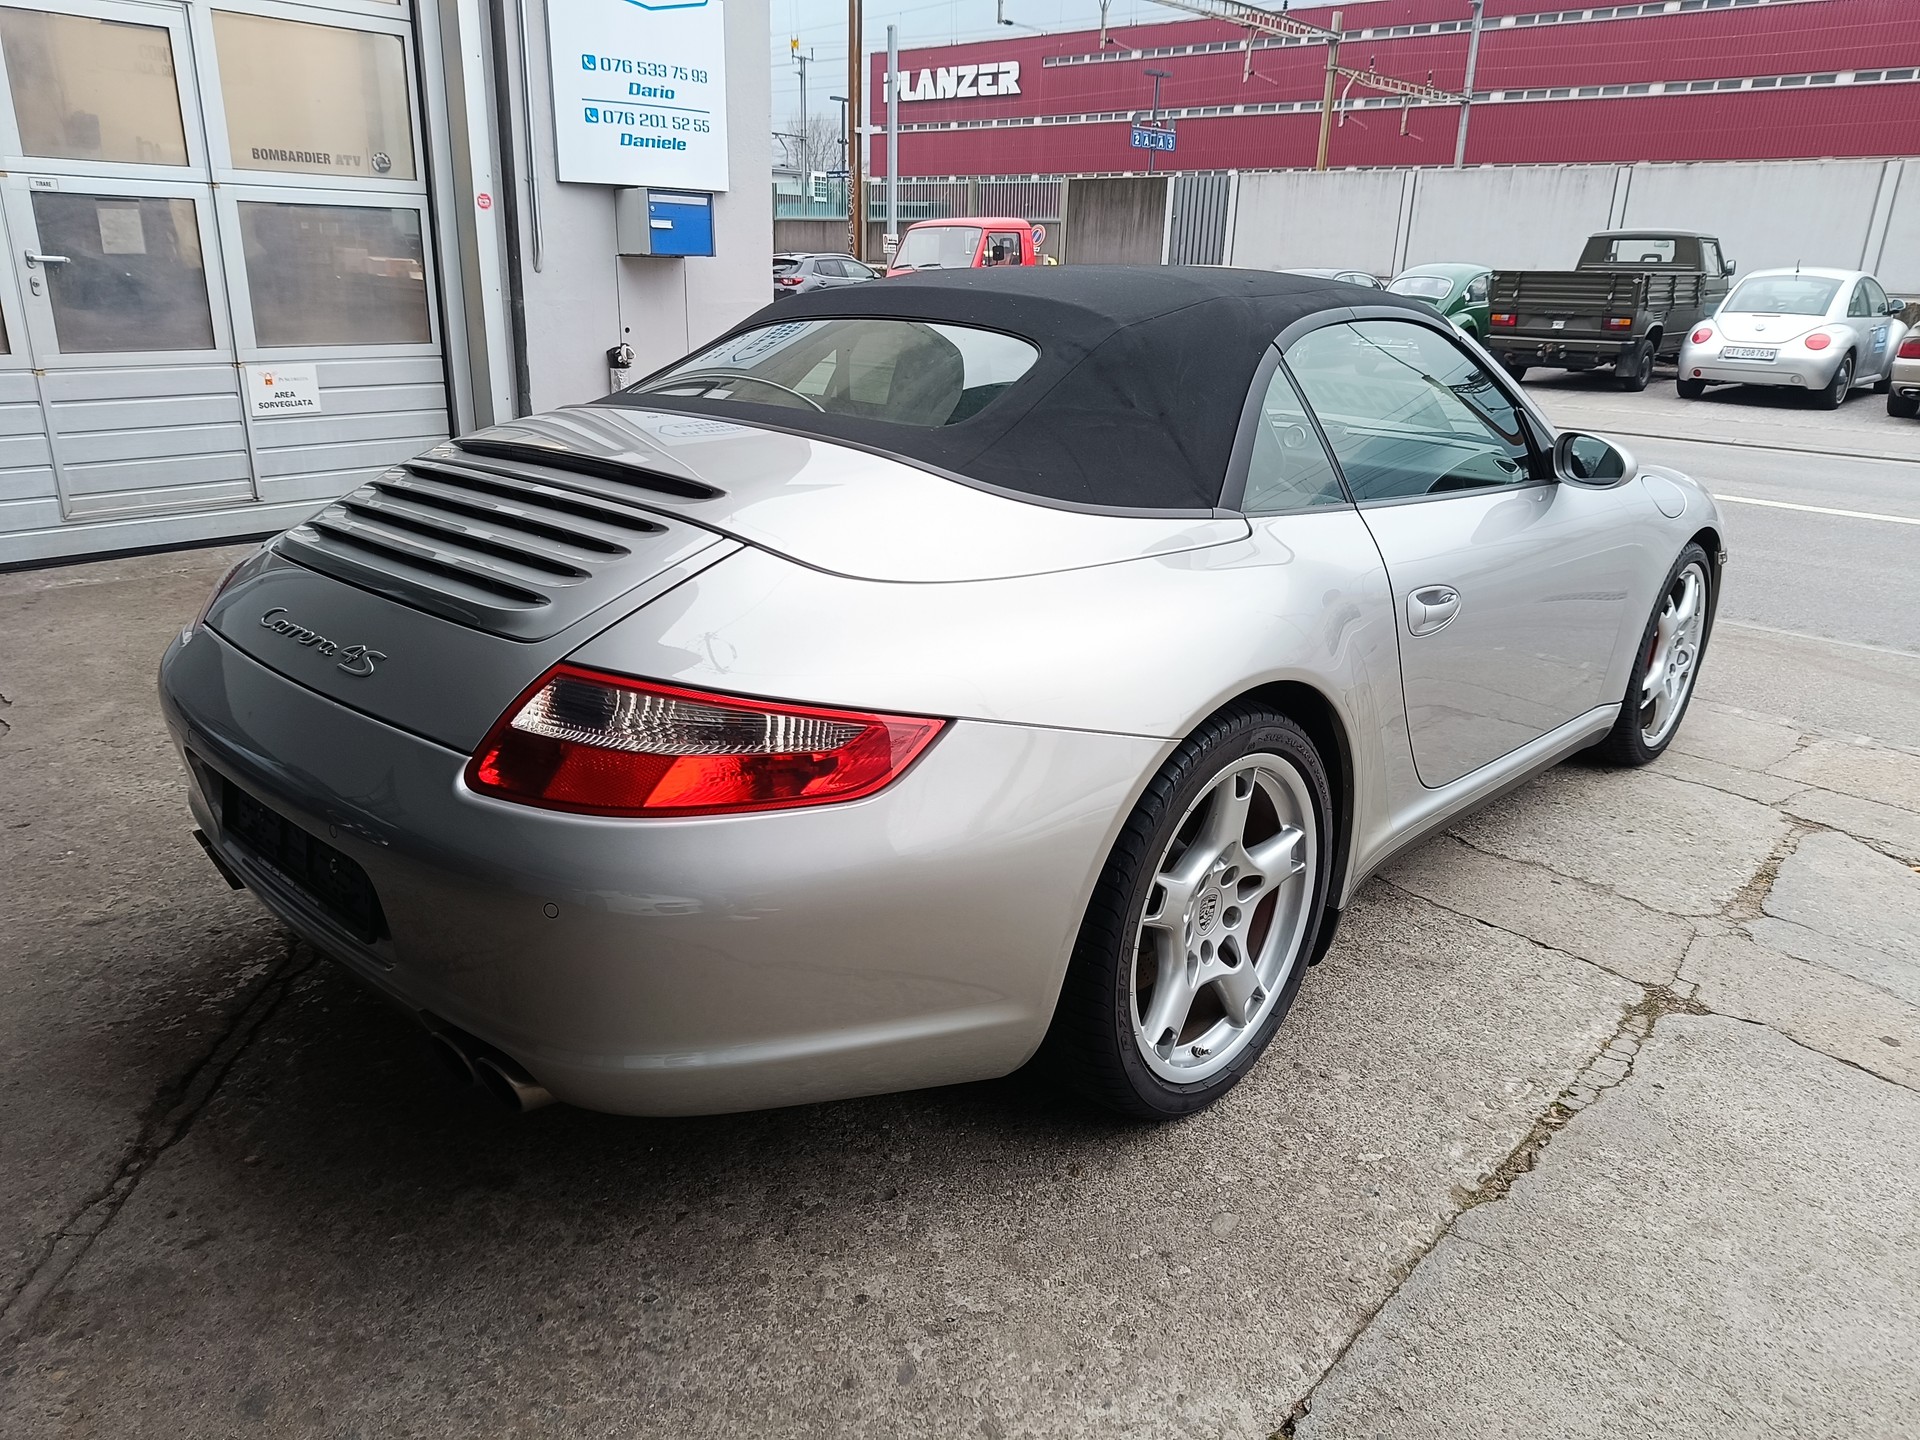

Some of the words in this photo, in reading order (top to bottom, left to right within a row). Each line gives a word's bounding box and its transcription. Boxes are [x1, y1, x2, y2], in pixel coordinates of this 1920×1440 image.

[600, 57, 633, 73] 076
[637, 61, 667, 78] 533
[670, 66, 688, 81] 75
[691, 69, 708, 84] 93
[628, 82, 675, 100] Dario
[603, 110, 635, 126] 076
[639, 113, 669, 129] 201
[672, 116, 690, 131] 52
[693, 119, 710, 134] 55
[620, 133, 687, 151] Daniele
[251, 147, 331, 165] BOMBARDIER
[335, 154, 361, 167] ATV
[258, 399, 314, 409] SORVEGLIATA
[274, 391, 296, 399] AREA
[260, 606, 338, 656] Carrera
[337, 644, 388, 677] 4S
